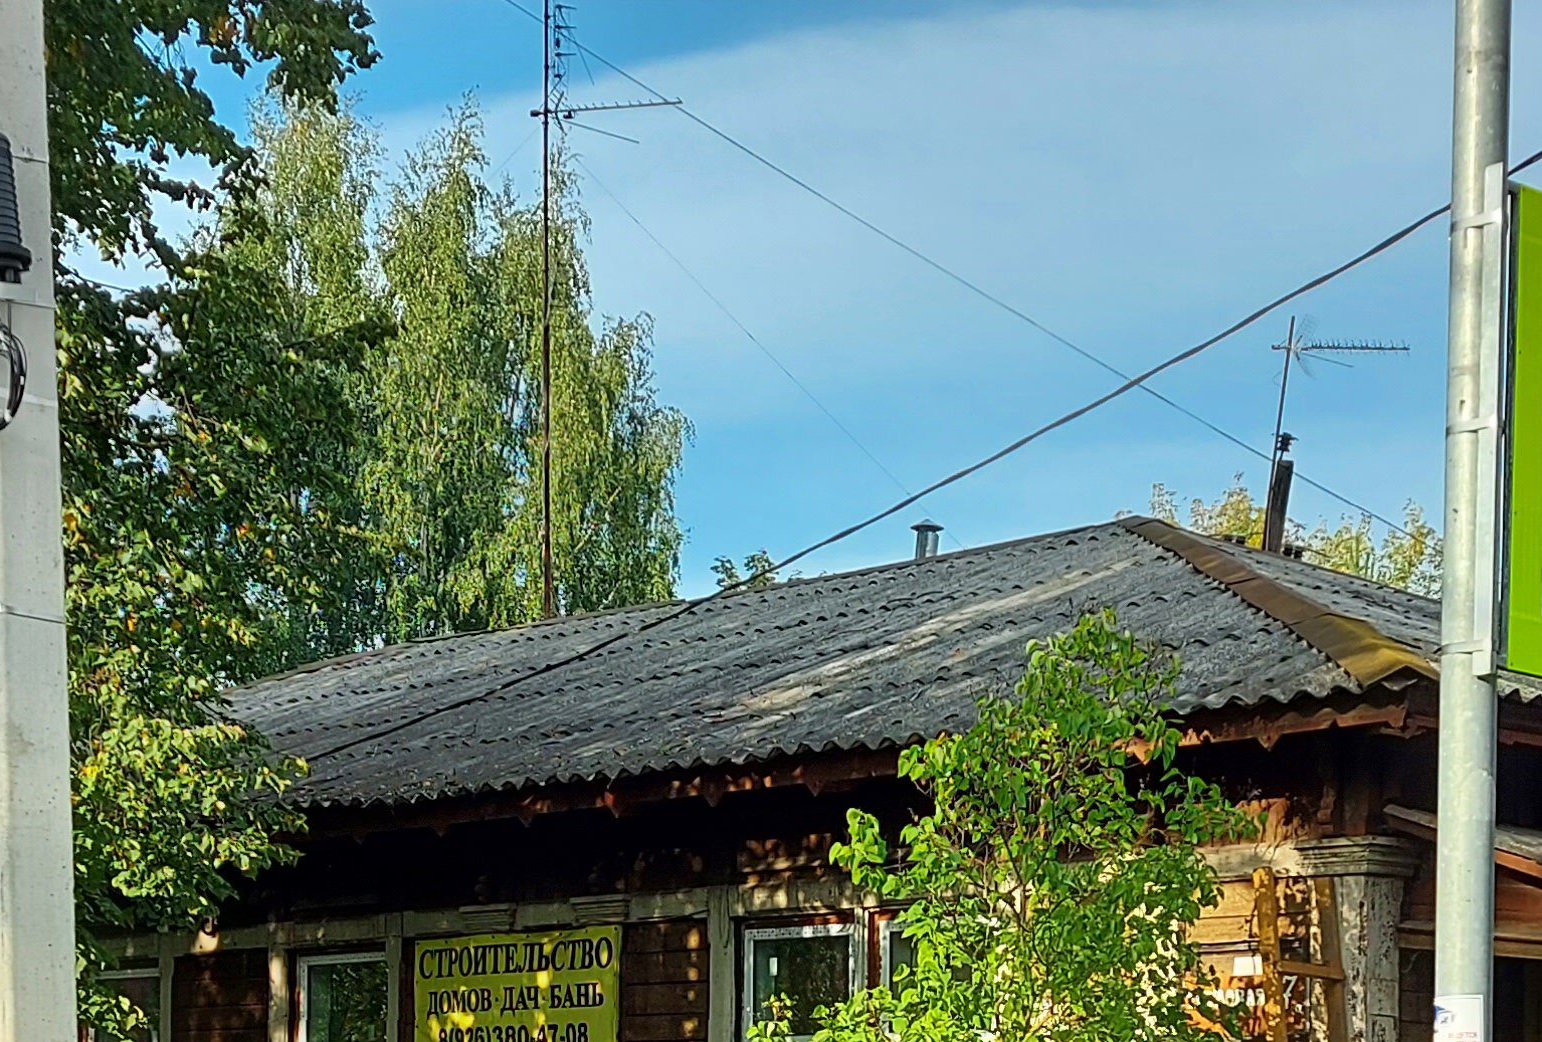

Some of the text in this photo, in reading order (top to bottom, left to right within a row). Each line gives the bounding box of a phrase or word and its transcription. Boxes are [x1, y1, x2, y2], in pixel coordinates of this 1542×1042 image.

[419, 937, 613, 979] СТРОИТЕЛЬСТВО
[427, 982, 604, 1020] ДОМОВ ДАЧ БАНЬ
